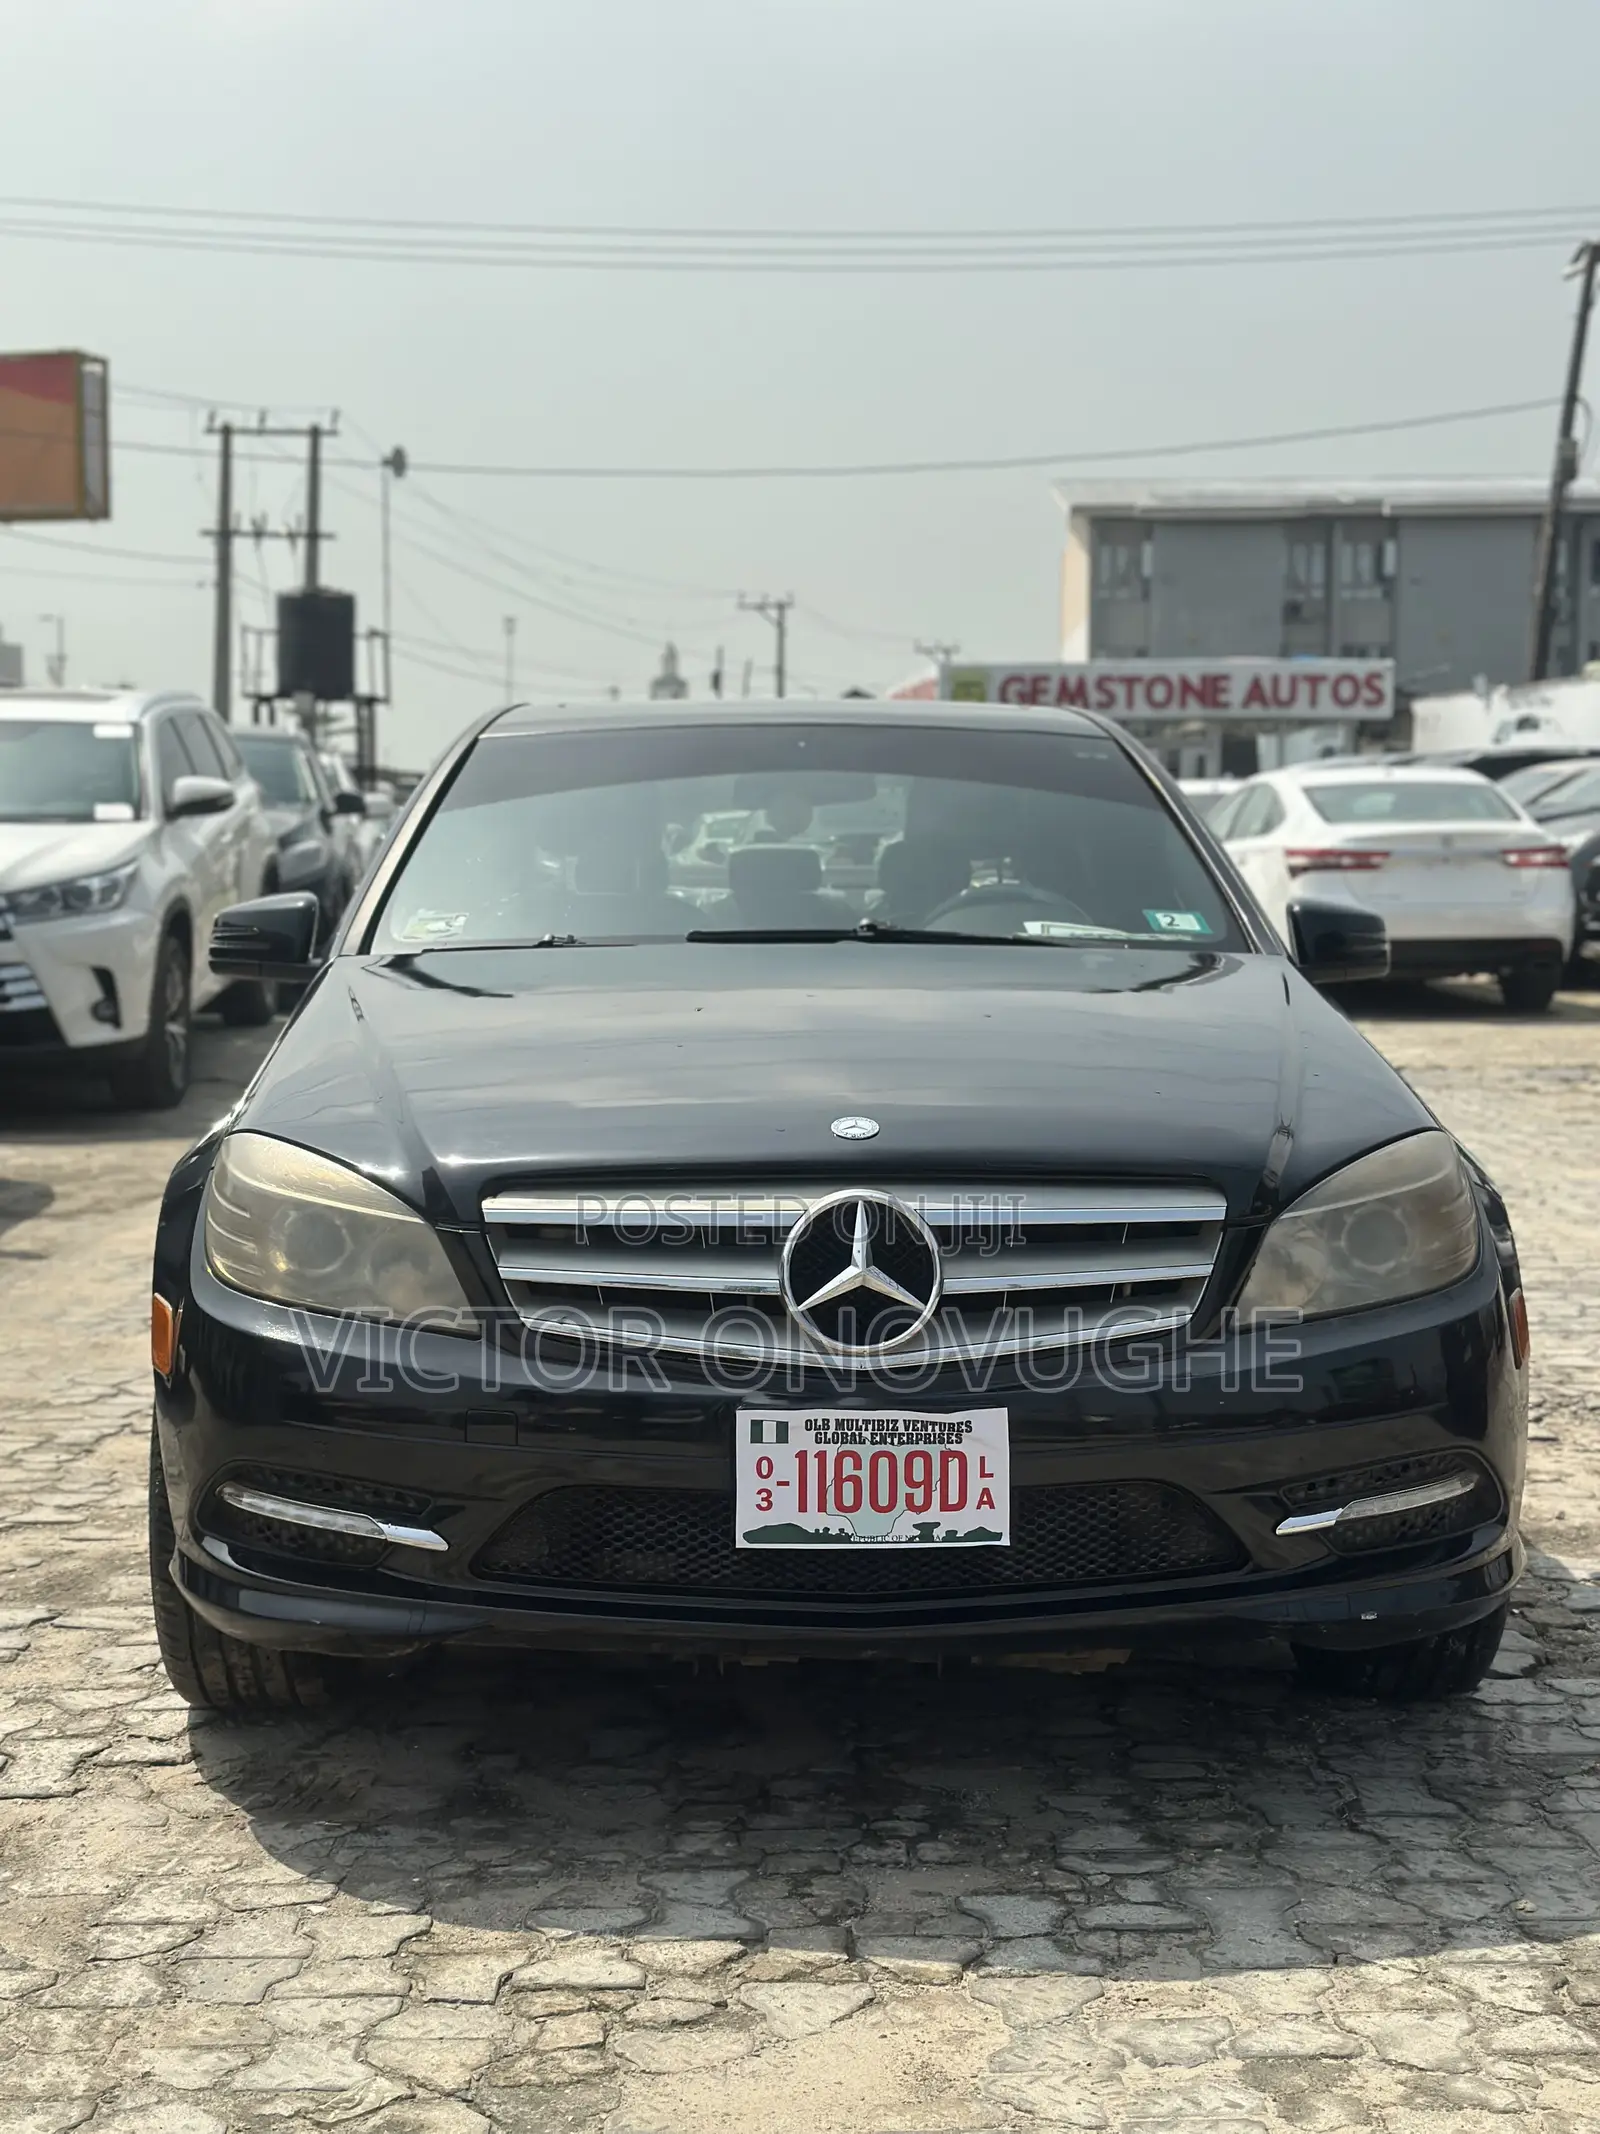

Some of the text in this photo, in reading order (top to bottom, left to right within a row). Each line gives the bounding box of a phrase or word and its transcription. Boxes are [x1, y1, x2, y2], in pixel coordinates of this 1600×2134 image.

[998, 671, 1387, 709] GEMSTONE AUTOS
[1163, 914, 1181, 927] 2
[834, 1418, 899, 1431] MULTIBIZ
[902, 1419, 973, 1433] VENTURES
[814, 1431, 963, 1445] GLOBAL ENTERPRISES
